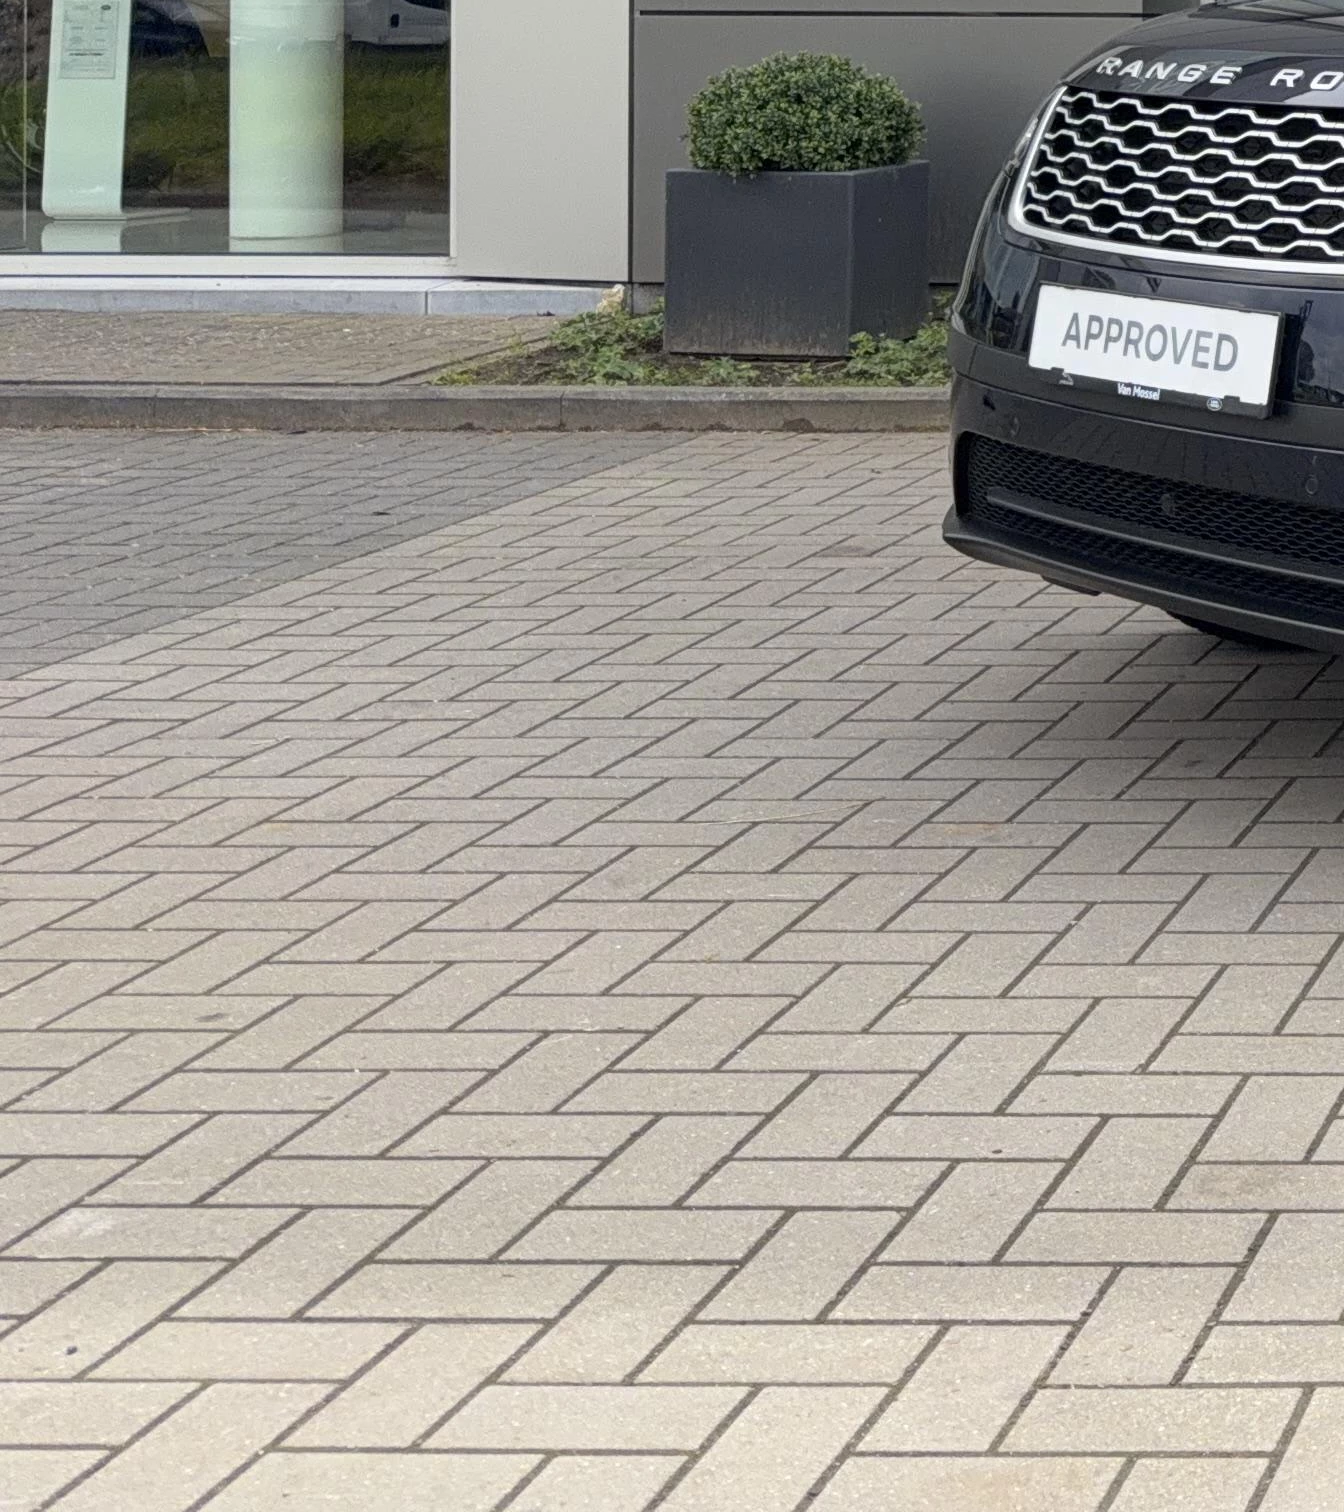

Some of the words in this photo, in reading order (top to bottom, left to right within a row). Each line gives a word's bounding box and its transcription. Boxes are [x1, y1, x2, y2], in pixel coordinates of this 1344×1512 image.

[1096, 56, 1243, 85] RANGE
[1060, 312, 1239, 373] APPROVED
[1117, 383, 1132, 396] Van
[1132, 385, 1160, 400] Mossel
